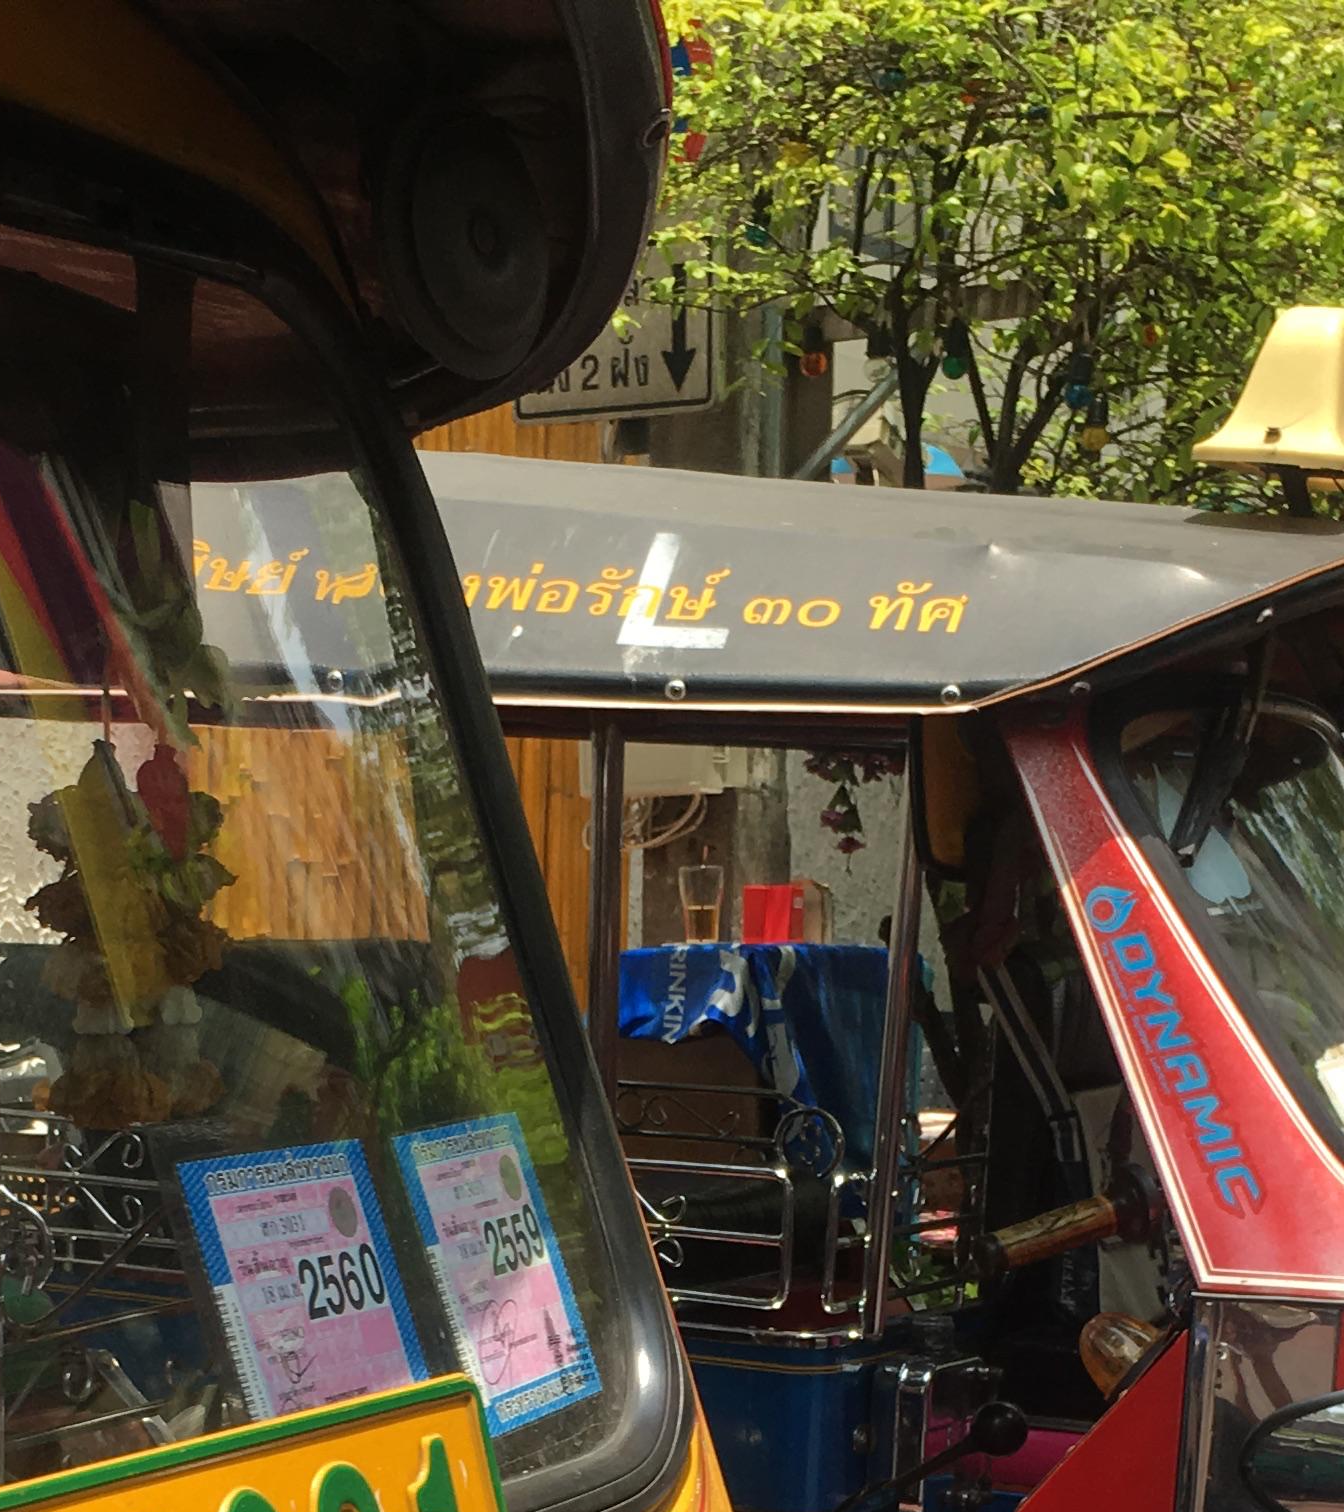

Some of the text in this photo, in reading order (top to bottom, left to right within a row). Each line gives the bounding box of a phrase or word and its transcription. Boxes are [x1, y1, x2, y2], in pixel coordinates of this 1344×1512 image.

[580, 355, 601, 391] 2
[192, 538, 310, 596] ิษย์
[741, 595, 841, 628] ๓๐
[867, 579, 970, 633] ทัศ
[661, 946, 689, 1045] RINKIN
[1110, 933, 1262, 1207] DYNAMIC
[298, 1243, 385, 1320] 2560
[483, 1203, 544, 1276] 2559
